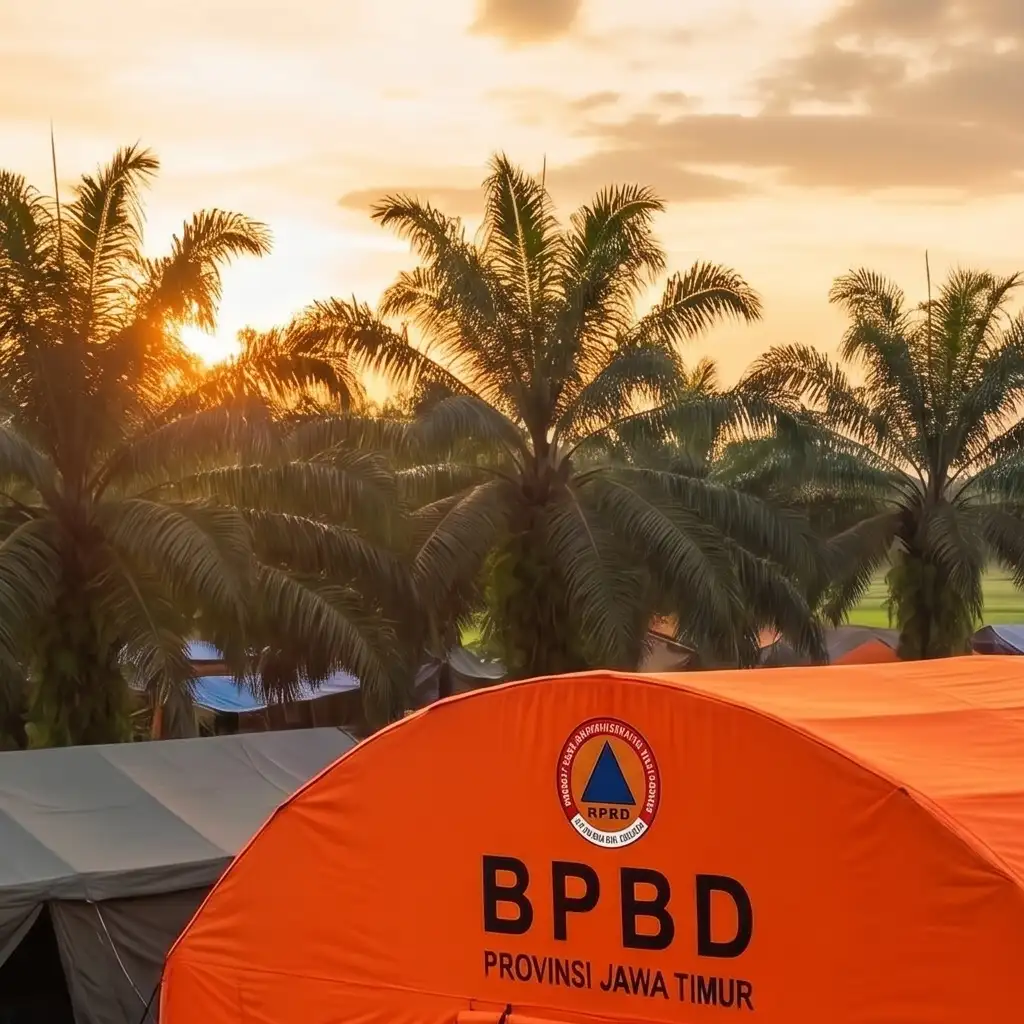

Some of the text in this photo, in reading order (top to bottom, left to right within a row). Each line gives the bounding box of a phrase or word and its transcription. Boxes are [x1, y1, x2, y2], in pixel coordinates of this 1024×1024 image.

[587, 806, 630, 820] RPRD
[482, 854, 754, 959] BPBD
[483, 949, 755, 1011] PROVINSI JAWA TIMUR
